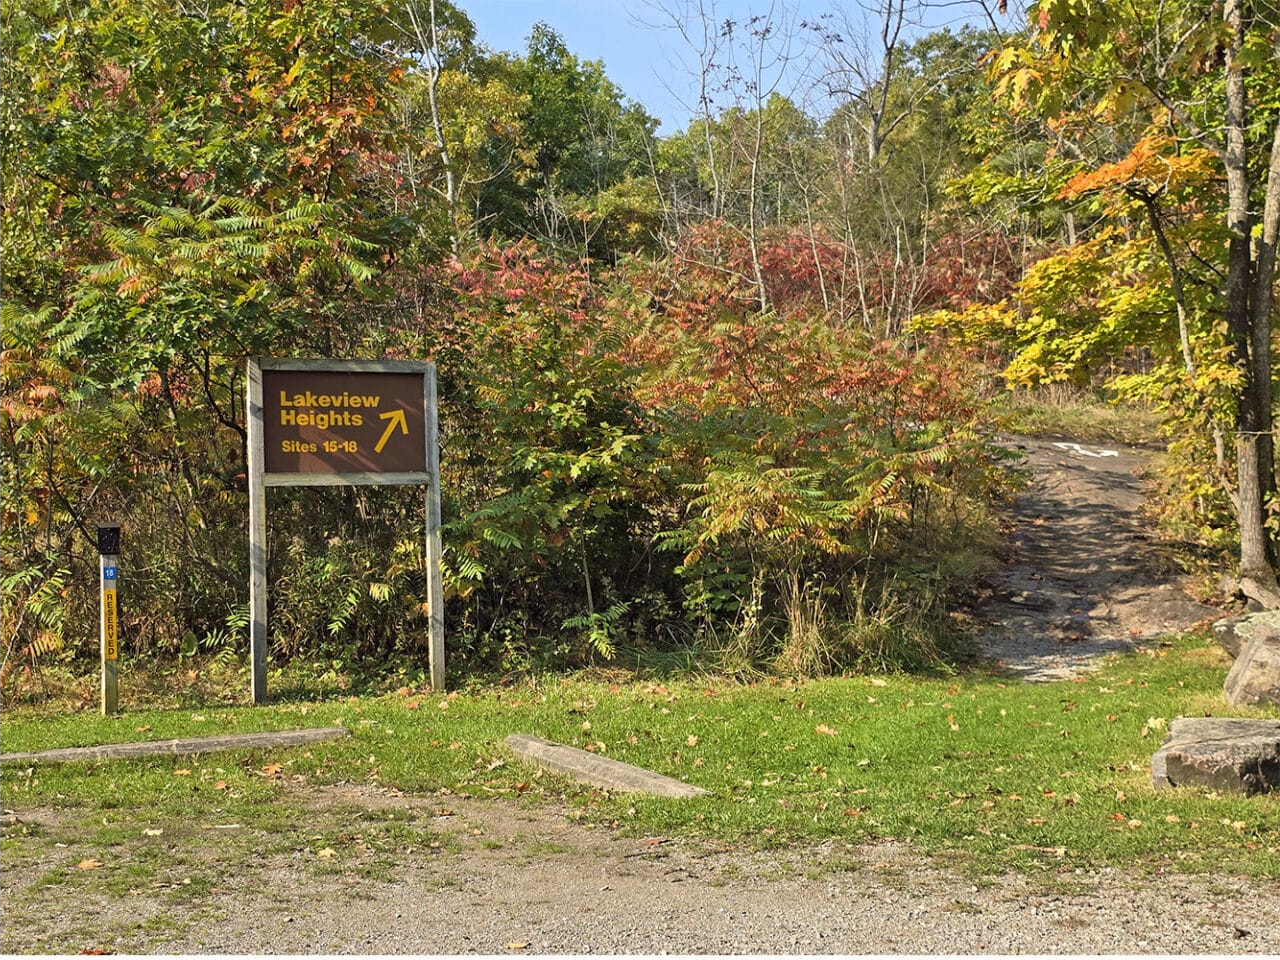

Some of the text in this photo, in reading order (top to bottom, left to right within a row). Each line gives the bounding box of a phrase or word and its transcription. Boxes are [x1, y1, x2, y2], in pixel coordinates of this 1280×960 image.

[280, 391, 380, 408] Lakeview
[280, 409, 363, 430] Heights
[281, 440, 358, 453] Sites 15-18
[106, 593, 115, 655] RESERVED
